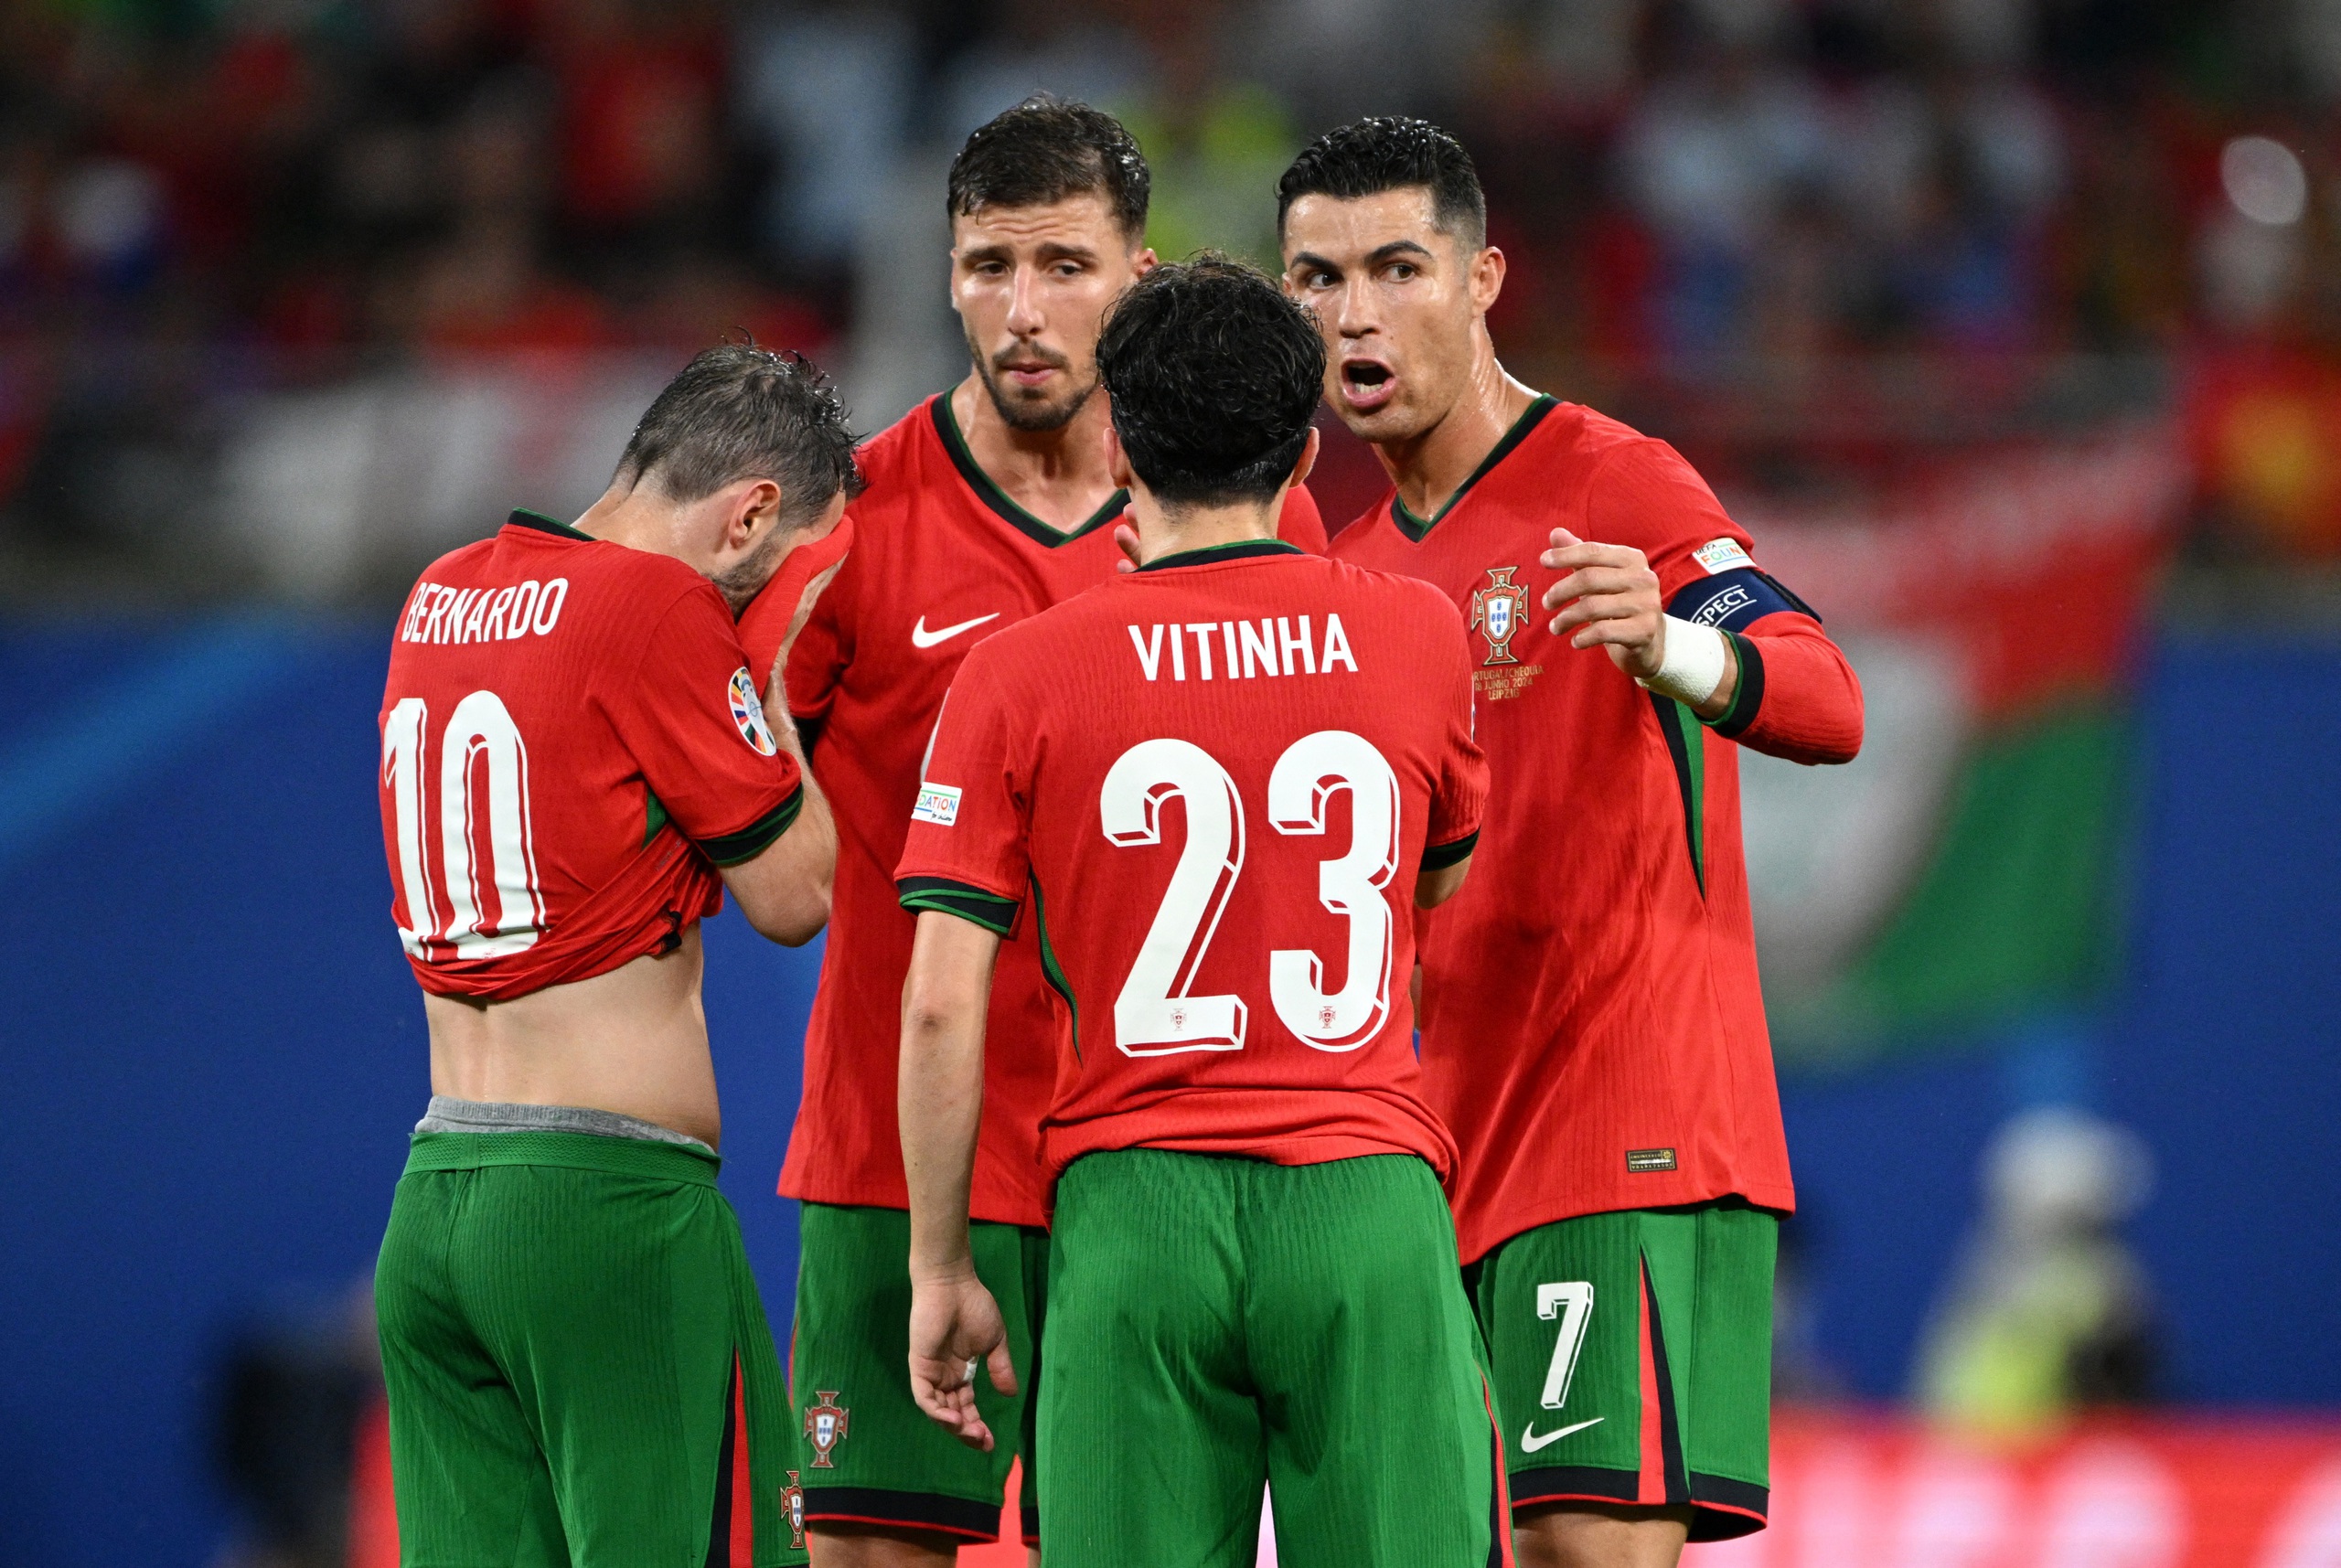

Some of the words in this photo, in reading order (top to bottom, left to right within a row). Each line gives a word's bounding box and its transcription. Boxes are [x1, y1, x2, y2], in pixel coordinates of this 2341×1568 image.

[1695, 543, 1717, 556] UEFA
[1701, 546, 1742, 564] FOUN
[401, 578, 569, 645] BERNARDO
[1696, 588, 1748, 626] SPECT
[1128, 613, 1359, 682] VITINHA
[1473, 665, 1545, 682] RTUGAL/CHEQUIA
[1484, 678, 1510, 690] JUNHO
[1513, 677, 1534, 688] 2024
[1489, 688, 1521, 700] LEIPZIG
[917, 794, 957, 813] DATION
[383, 689, 551, 963] 10
[1099, 731, 1401, 1059] 23
[1537, 1281, 1594, 1410] 7
